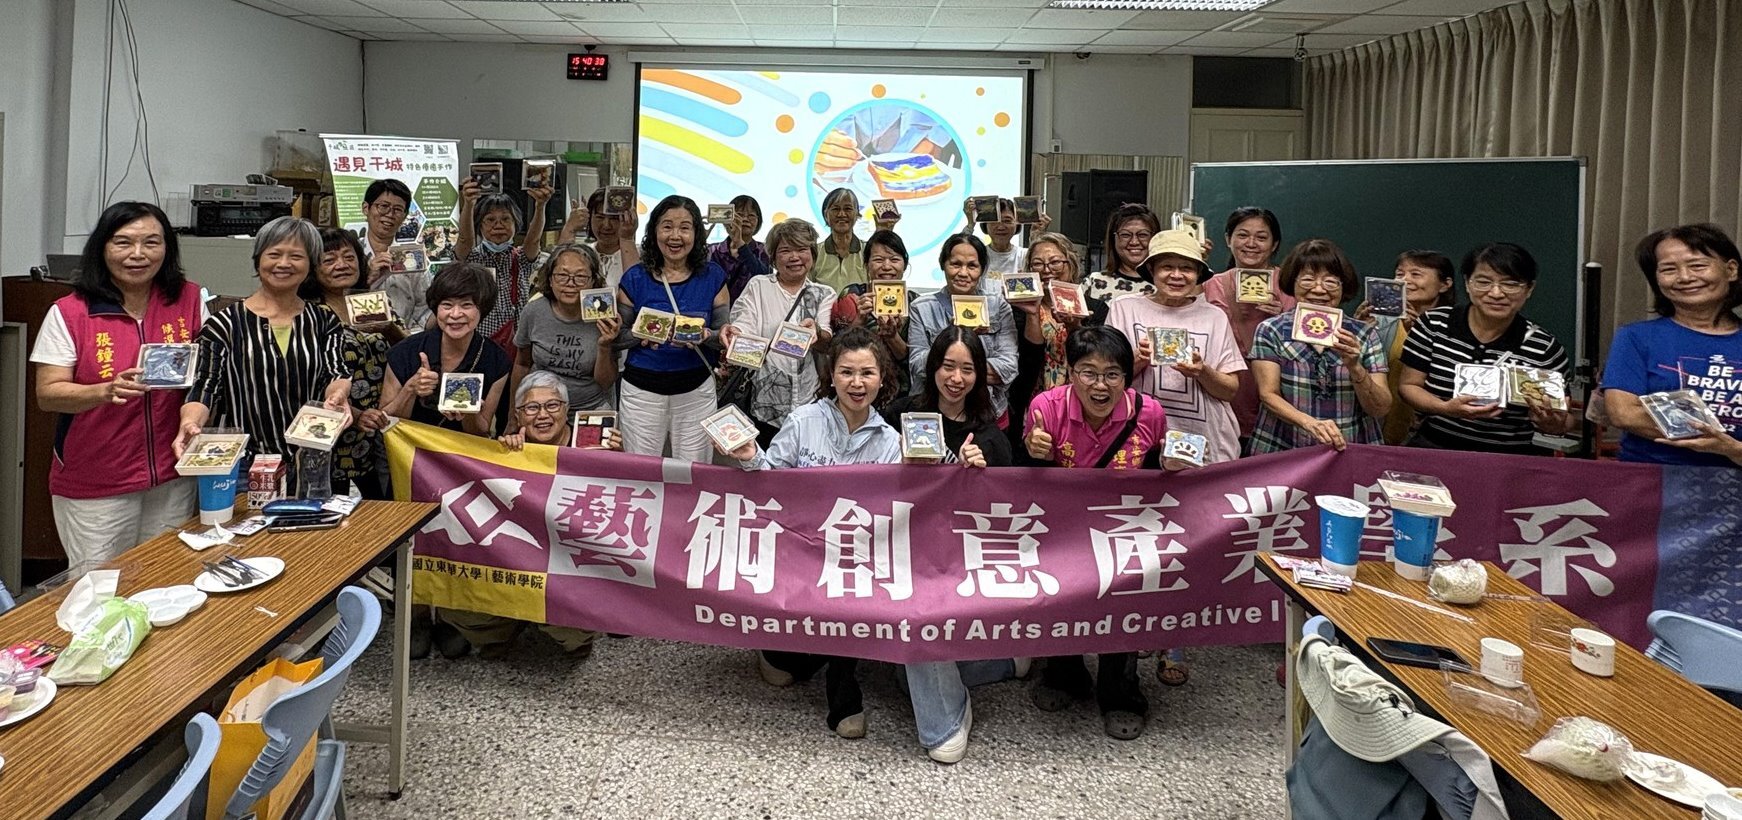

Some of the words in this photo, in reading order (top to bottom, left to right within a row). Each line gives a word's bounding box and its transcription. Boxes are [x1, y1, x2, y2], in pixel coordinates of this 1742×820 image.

[572, 57, 580, 65] 15
[582, 57, 593, 65] 40
[556, 334, 582, 347] THIS
[95, 331, 115, 379] 張鐘云
[550, 345, 561, 356] IS
[565, 348, 584, 362] MY
[1707, 365, 1735, 378] BE
[1701, 389, 1728, 403] BE
[1708, 403, 1742, 419] ERO
[413, 557, 482, 580] 國立東華大學
[491, 569, 544, 590] 藝術學院
[694, 603, 911, 643] Department
[920, 617, 957, 642] of
[964, 617, 1042, 642] Arts
[1050, 614, 1113, 639] and
[1121, 601, 1265, 634] Creative
